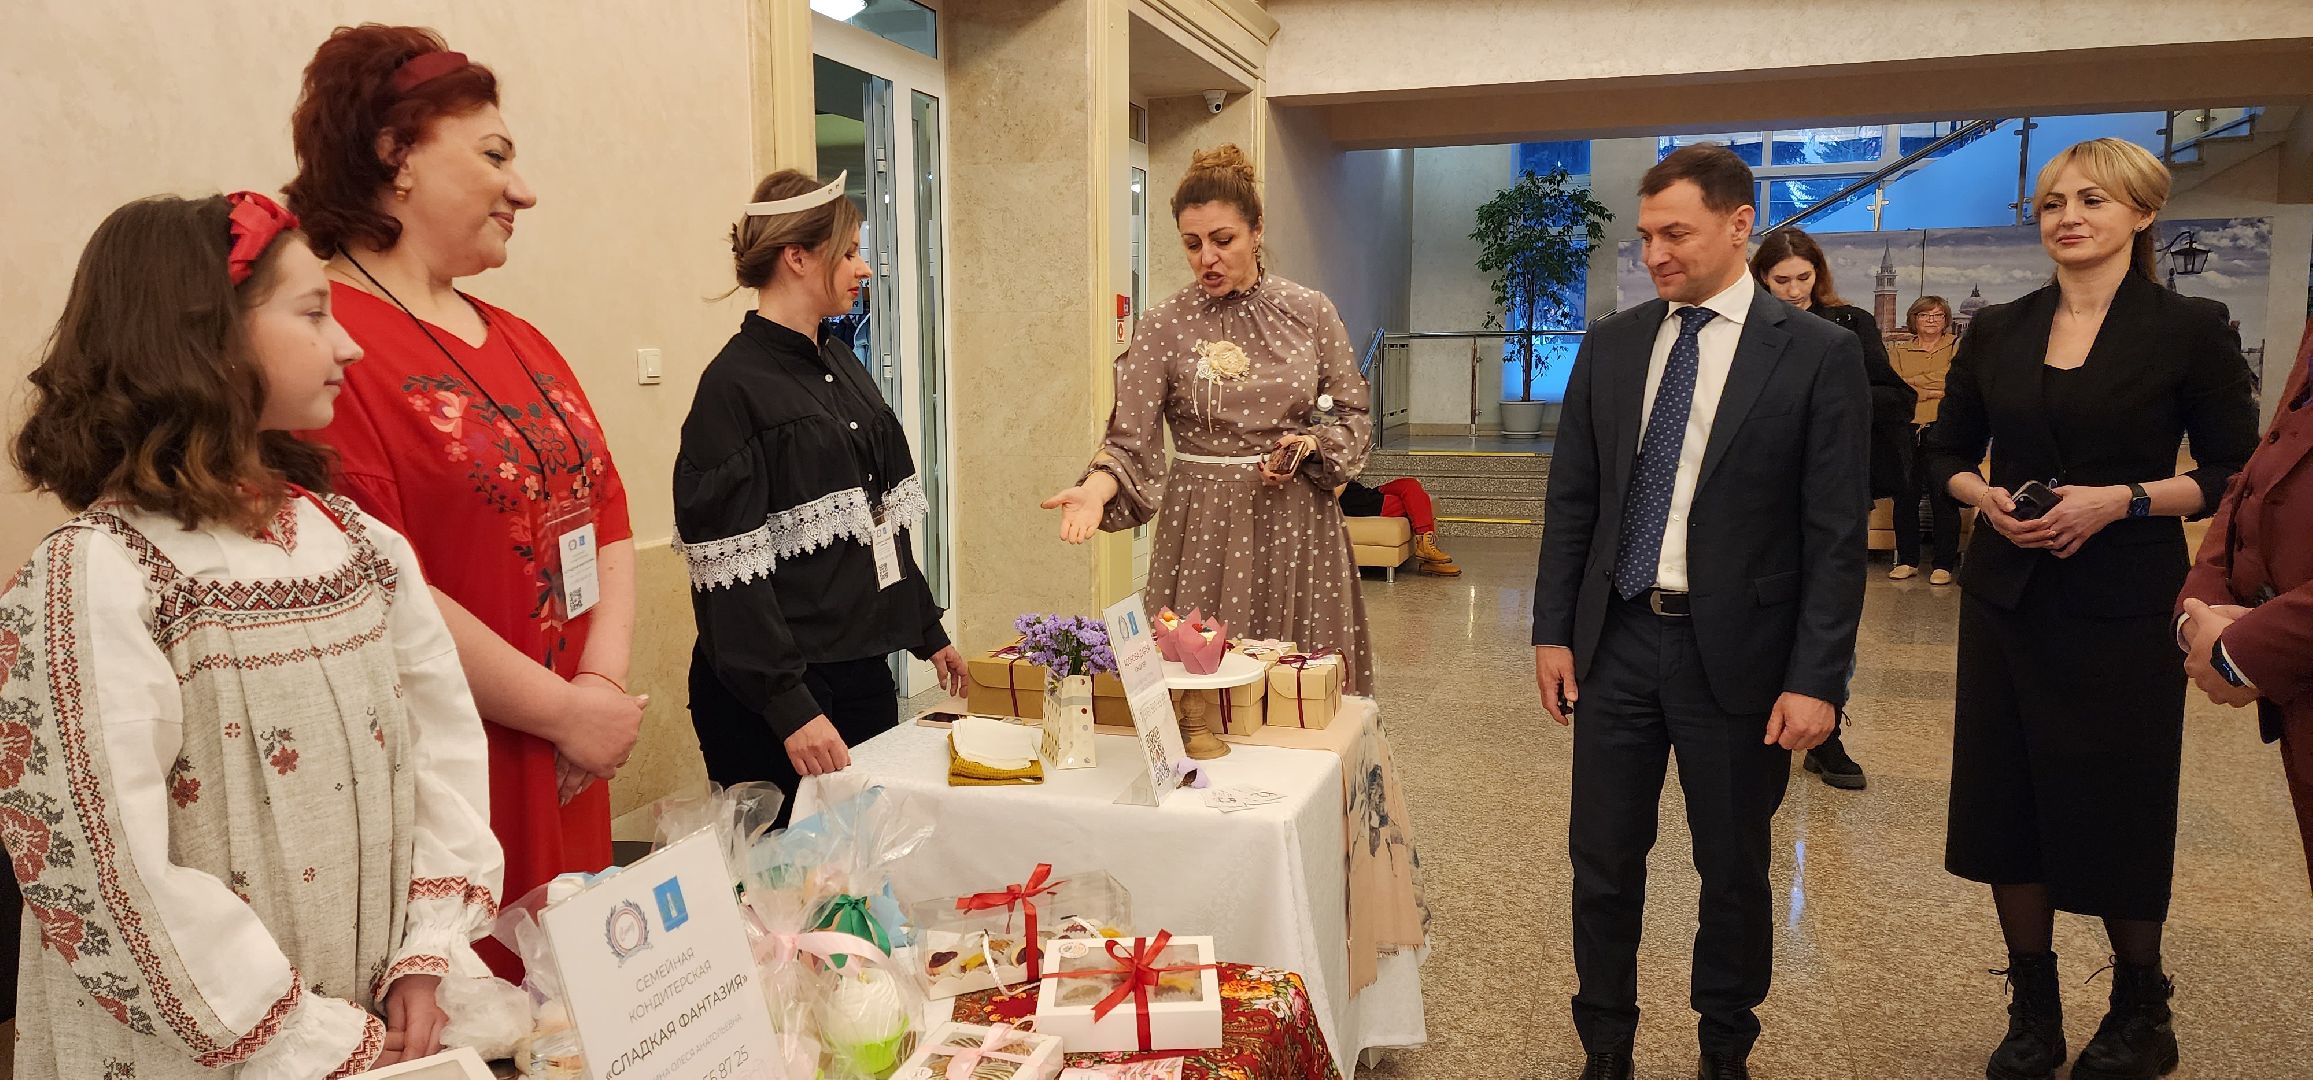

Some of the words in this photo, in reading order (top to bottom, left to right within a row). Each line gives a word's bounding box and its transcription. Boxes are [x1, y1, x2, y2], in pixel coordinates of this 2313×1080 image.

[629, 960, 712, 1024] КОНДИТЕРСКАЯ
[636, 947, 695, 992] СЕМЕЙНАЯ
[605, 1020, 677, 1080] «СЛАДКАЯ
[678, 973, 748, 1028] ФАНТАЗИЯ»
[671, 1048, 696, 1072] ОЛЕСЯ
[696, 1013, 743, 1055] АНАТОЛЬЕВНА
[718, 1056, 734, 1079] 87
[734, 1044, 749, 1067] 25
